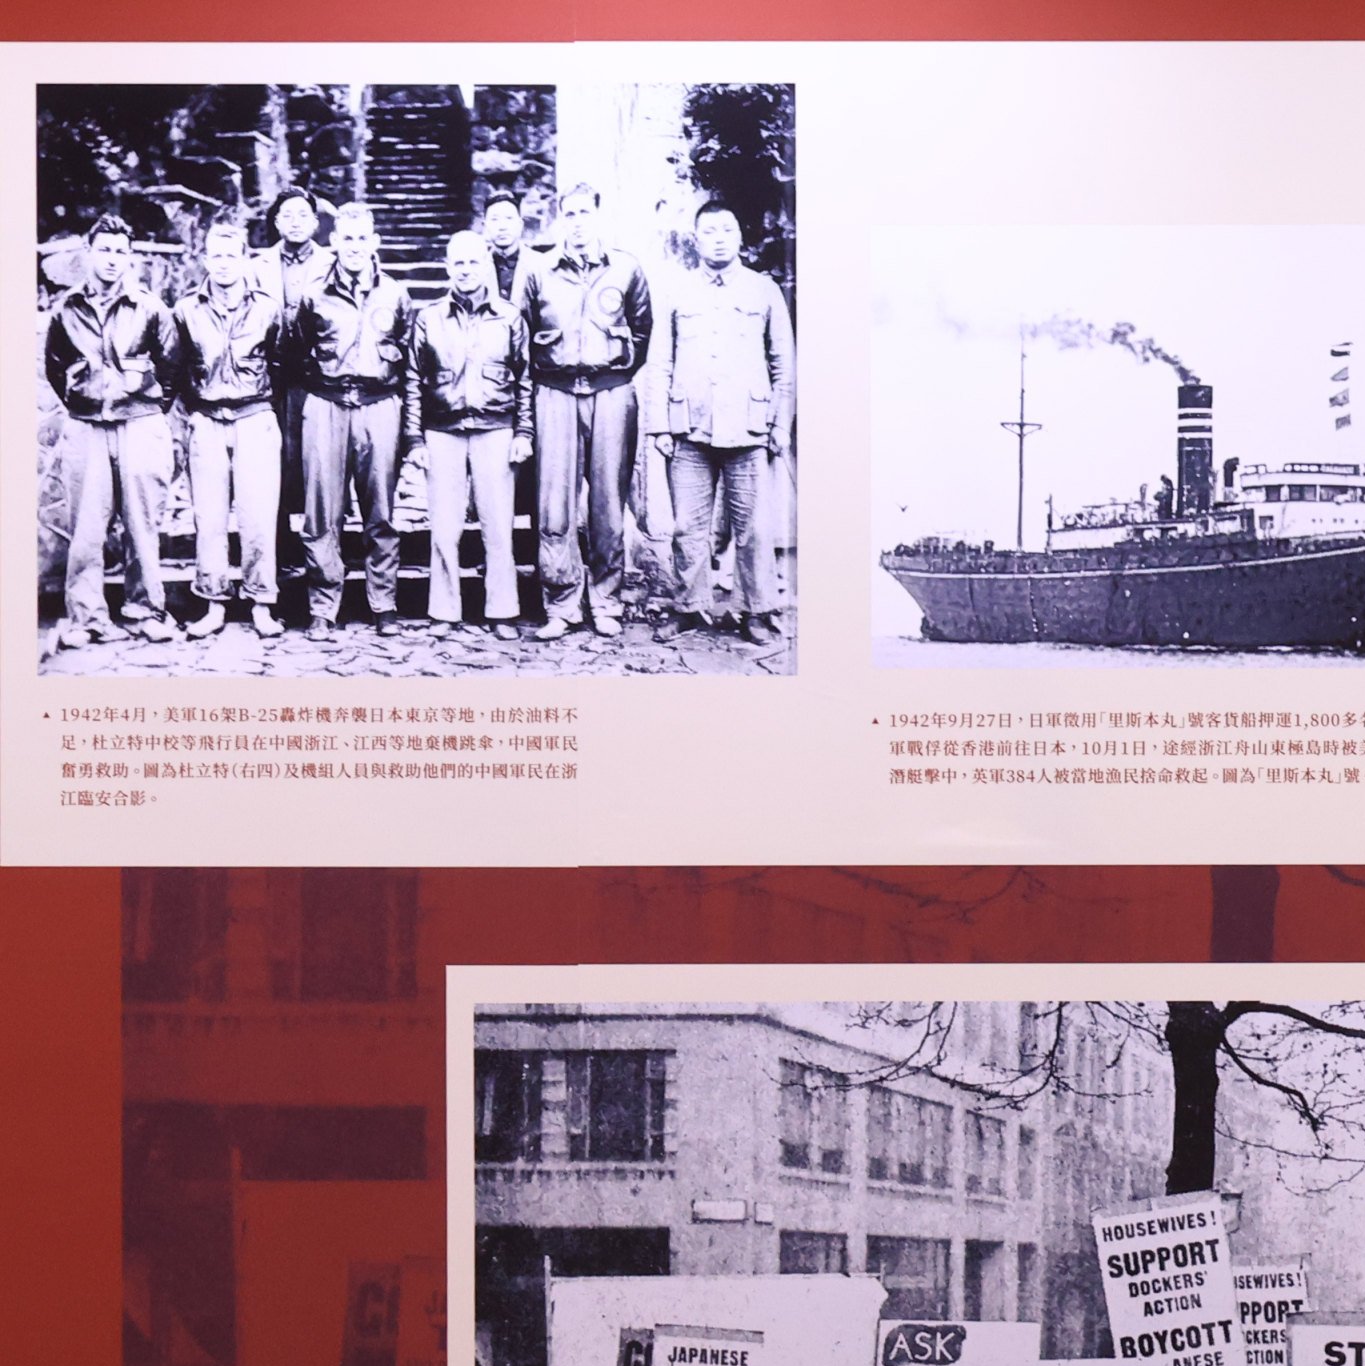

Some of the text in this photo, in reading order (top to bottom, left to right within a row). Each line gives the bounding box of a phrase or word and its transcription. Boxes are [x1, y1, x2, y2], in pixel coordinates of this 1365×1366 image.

[60, 789, 158, 807] 江臨安合影。
[1102, 1210, 1216, 1242] HOUSEWIVES!
[1106, 1238, 1220, 1278] SUPPORT
[1127, 1271, 1208, 1298] DOCKERS'
[1142, 1293, 1202, 1317] ACTION
[888, 1331, 956, 1362] ASK
[1119, 1320, 1233, 1359] BOYCOTT
